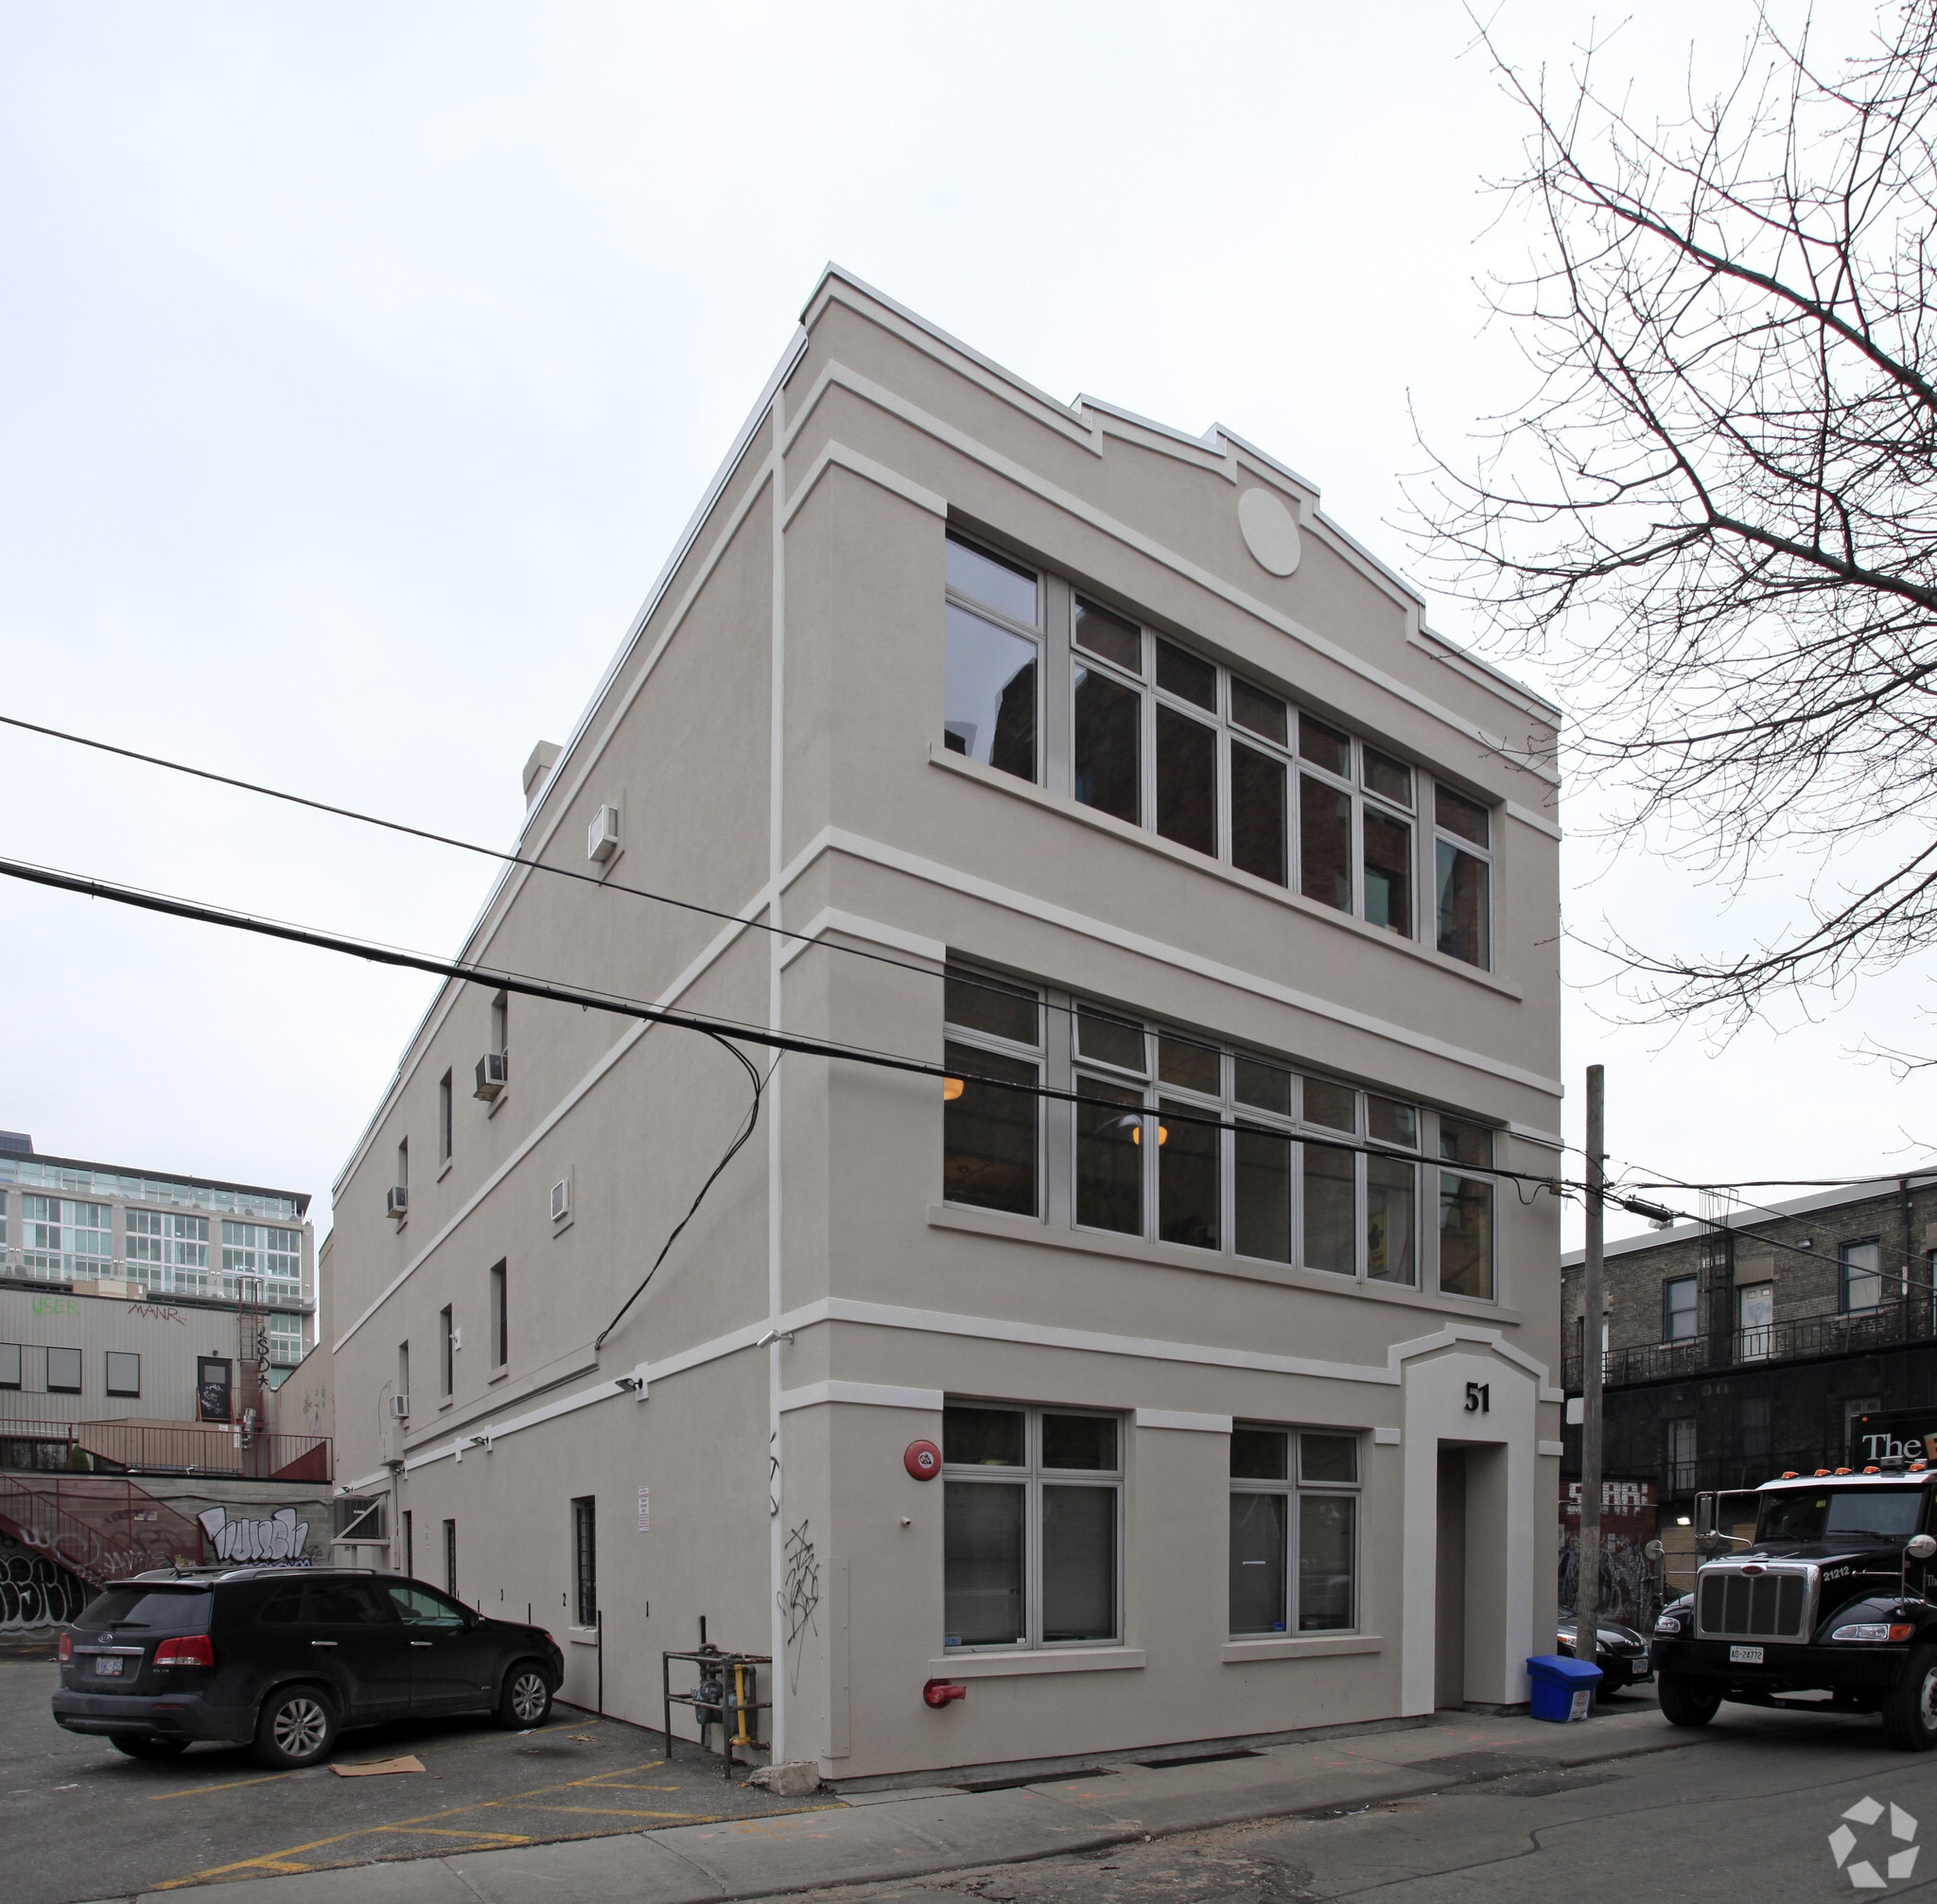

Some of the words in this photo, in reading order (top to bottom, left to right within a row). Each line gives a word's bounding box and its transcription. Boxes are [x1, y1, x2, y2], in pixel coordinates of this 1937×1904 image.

[32, 1296, 79, 1315] USER
[1465, 1381, 1490, 1412] 51
[1861, 1433, 1922, 1460] The
[1823, 1566, 1849, 1581] 21212
[563, 1592, 567, 1607] 2
